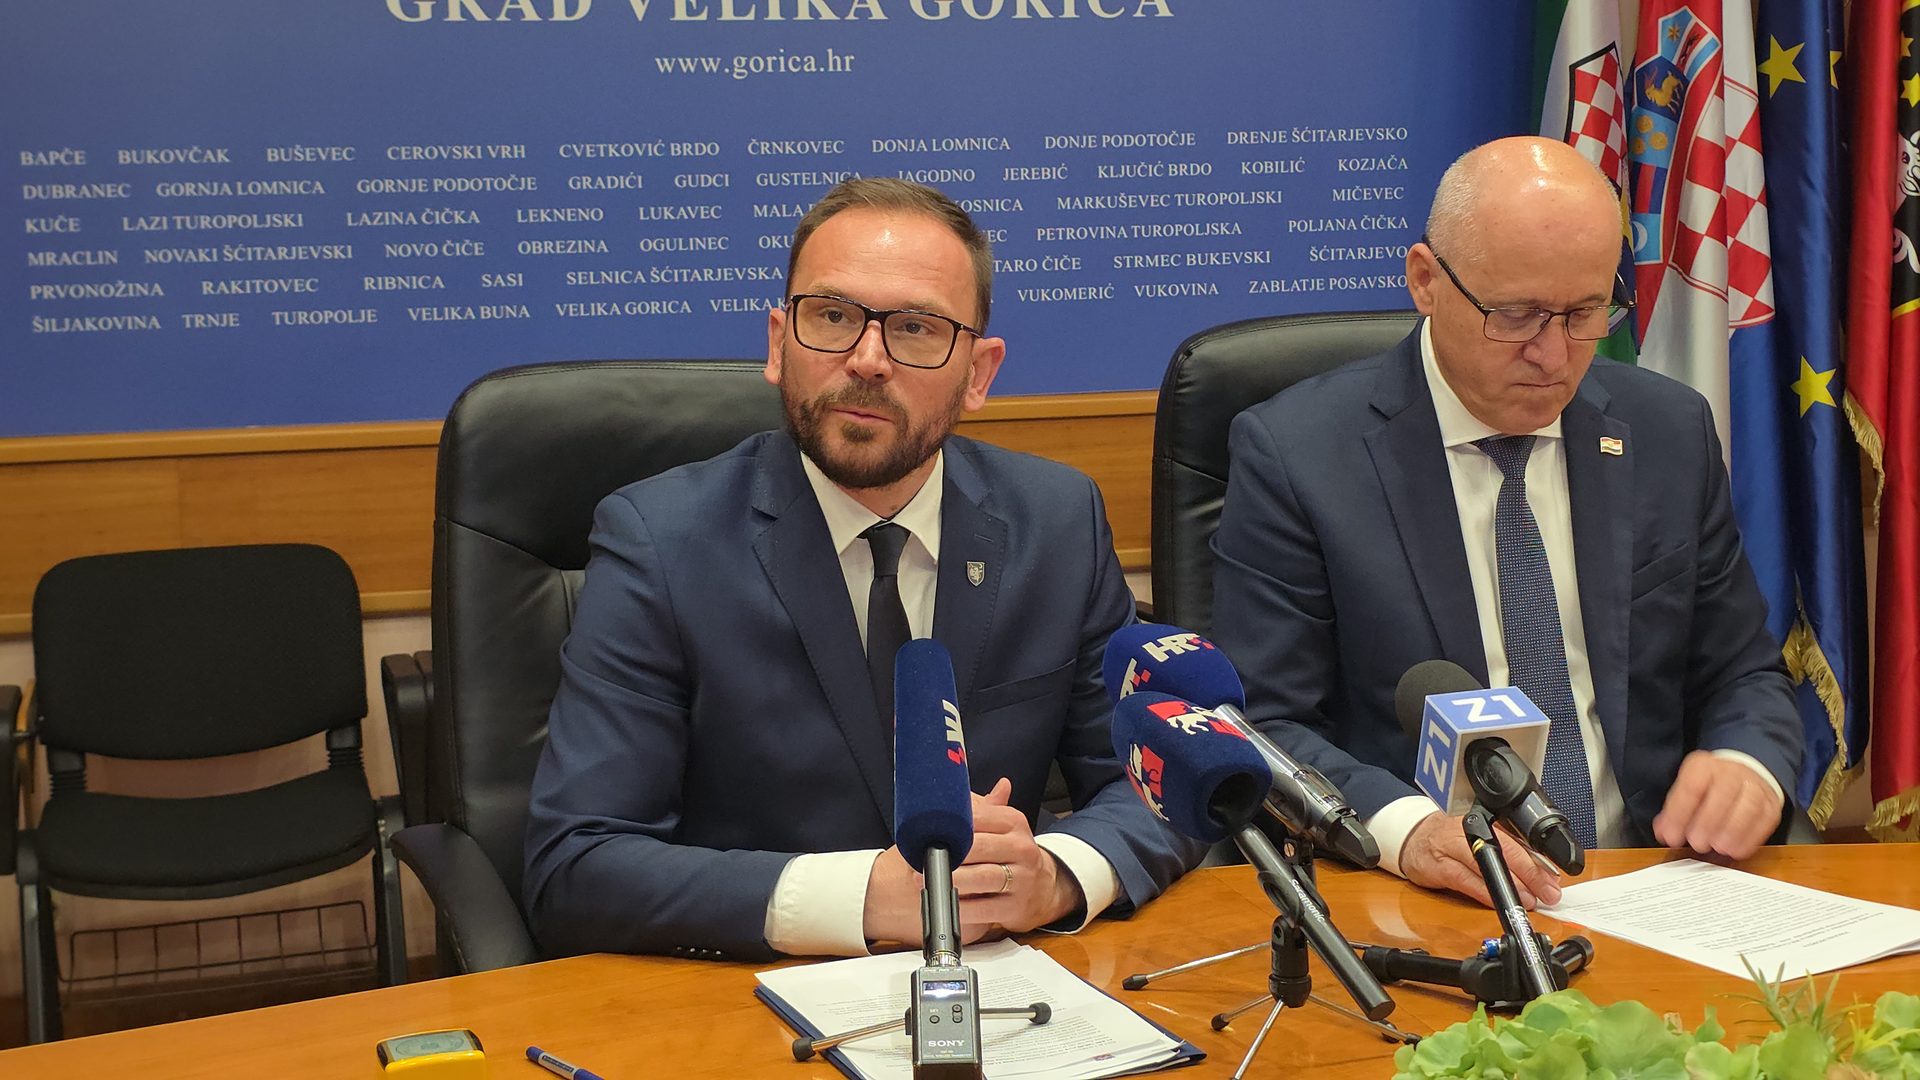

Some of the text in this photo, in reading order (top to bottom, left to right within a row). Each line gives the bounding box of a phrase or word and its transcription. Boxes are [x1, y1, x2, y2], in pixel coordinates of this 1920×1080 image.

[655, 48, 855, 80] www.gorica.hr
[20, 126, 1408, 165] BAPČE BUKOVČAK BUŠEVEC CEROVSKI VRH CVETKOVIĆ BRDO ČRNKOVEC DONJA LOMNICA DONJE PODOTOČJE DRENJE ŠĆITARJEVSKO
[23, 183, 130, 199] DUBRANEC
[156, 182, 233, 197] GORNJA
[236, 180, 325, 195] LOMNICA
[356, 179, 428, 193] GORNJE
[433, 174, 537, 192] PODOTOČJE
[568, 172, 642, 190] GRADIĆI
[674, 173, 729, 188] GUDCI
[1003, 163, 1067, 181] JEREBIĆ
[1098, 161, 1164, 178] KLJUČIĆ
[1169, 163, 1212, 176] BRDO
[1242, 157, 1305, 174] KOBILIĆ
[1338, 155, 1408, 171] KOZJAČA
[25, 215, 80, 233] KUČE
[123, 216, 168, 231] LAZI
[172, 213, 303, 229] TUROPOLJSKI
[347, 212, 418, 226] LAZINA
[421, 208, 480, 225] ČIČKA
[517, 208, 604, 223] LEKNENO
[639, 205, 722, 220] LUKAVEC
[753, 204, 804, 218] MALA
[955, 199, 1023, 212] OSNICA
[1057, 193, 1170, 209] MARKUŠEVEC
[1174, 191, 1282, 206] TUROPOLJSKI
[1333, 186, 1404, 201] MIČEVEC
[28, 214, 1408, 266] MRACLIN NOVAKI ŠĆITARJEVSKI NOVO ČIČE OBREZINA OGULINEC OKU PETROVINA TUROPOLJSKA POLJANA ČIČKA
[30, 245, 1408, 299] PRVONOŽINA RAKITOVEC RIBNICA SASI SELNICA ŠĆITARJEVSKA TARO ČIČE STRMEC BUKEVSKI ŠĆITARJEVO
[32, 316, 161, 333] ŠILJAKOVINA
[182, 313, 240, 328] TRNJE
[272, 309, 377, 325] TUROPOLJE
[407, 307, 475, 321] VELIKA
[480, 305, 530, 319] BUNA
[555, 303, 621, 317] VELIKA
[624, 300, 692, 315] GORICA
[710, 298, 773, 313] VELIKA
[1017, 283, 1114, 302] VUKOMERIĆ
[1134, 283, 1218, 297] VUKOVINA
[1249, 278, 1325, 293] ZABLATJE
[1329, 274, 1407, 291] POSAVSKO
[1452, 694, 1527, 723] Z1
[1423, 719, 1451, 793] Z1
[1291, 878, 1326, 923] Saramonic
